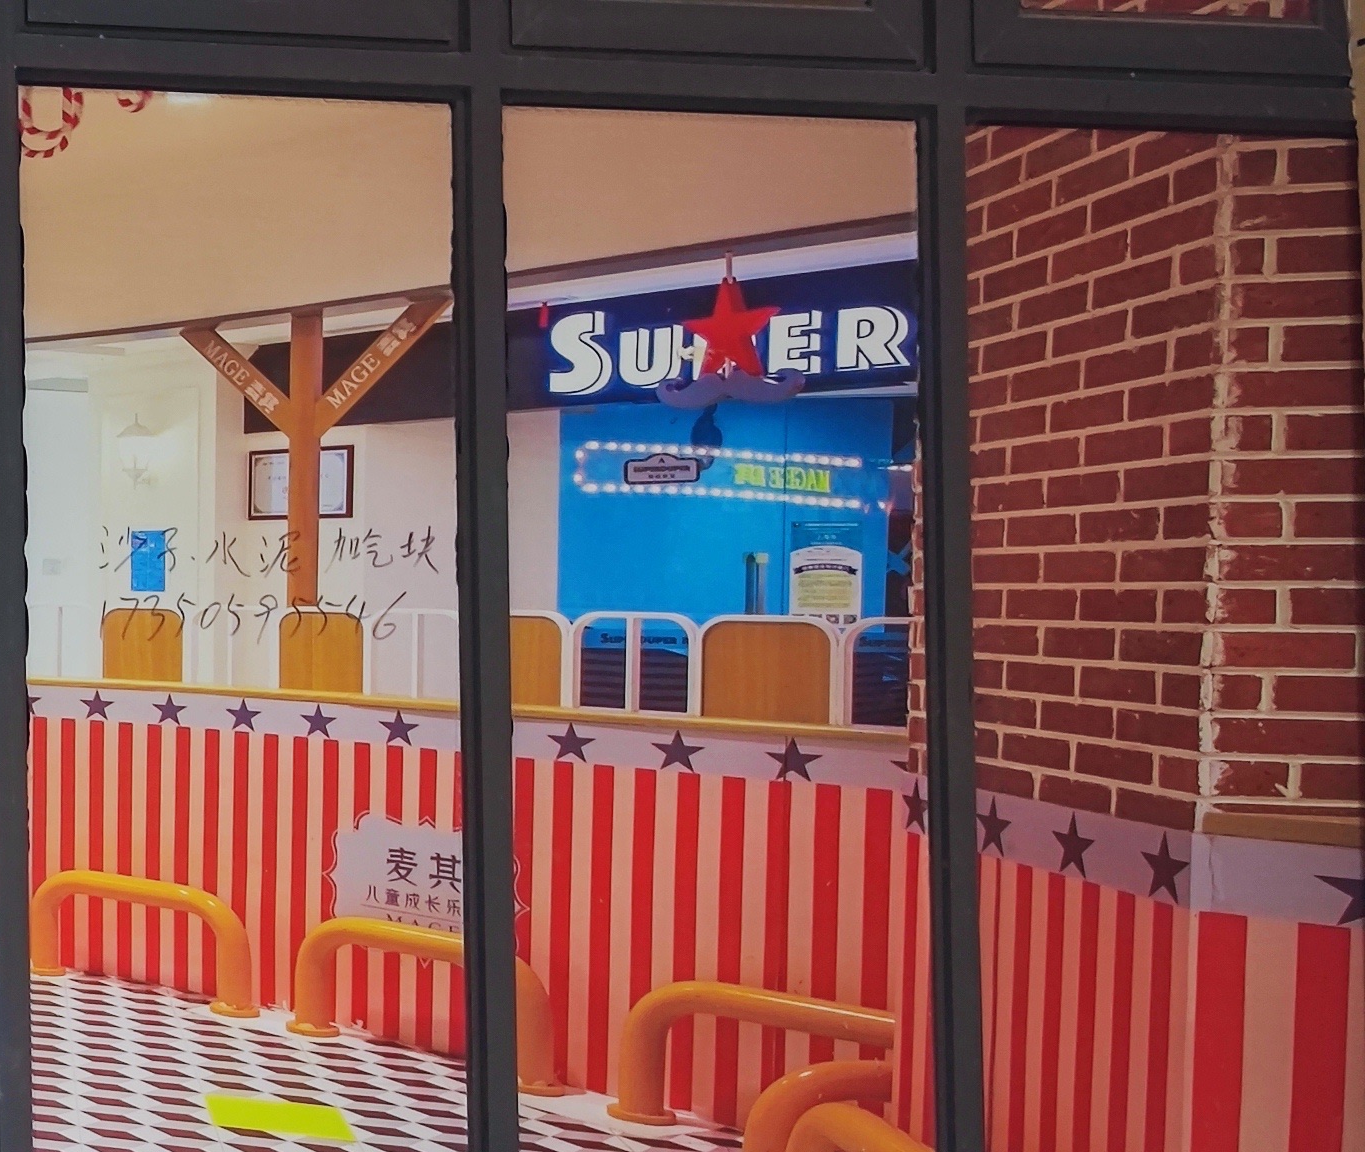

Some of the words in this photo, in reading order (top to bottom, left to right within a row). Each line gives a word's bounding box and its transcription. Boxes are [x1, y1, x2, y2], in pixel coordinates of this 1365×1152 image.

[204, 339, 250, 386] MAGE
[548, 305, 911, 396] SUER
[325, 353, 381, 409] MAGE
[386, 847, 462, 894] 麦其
